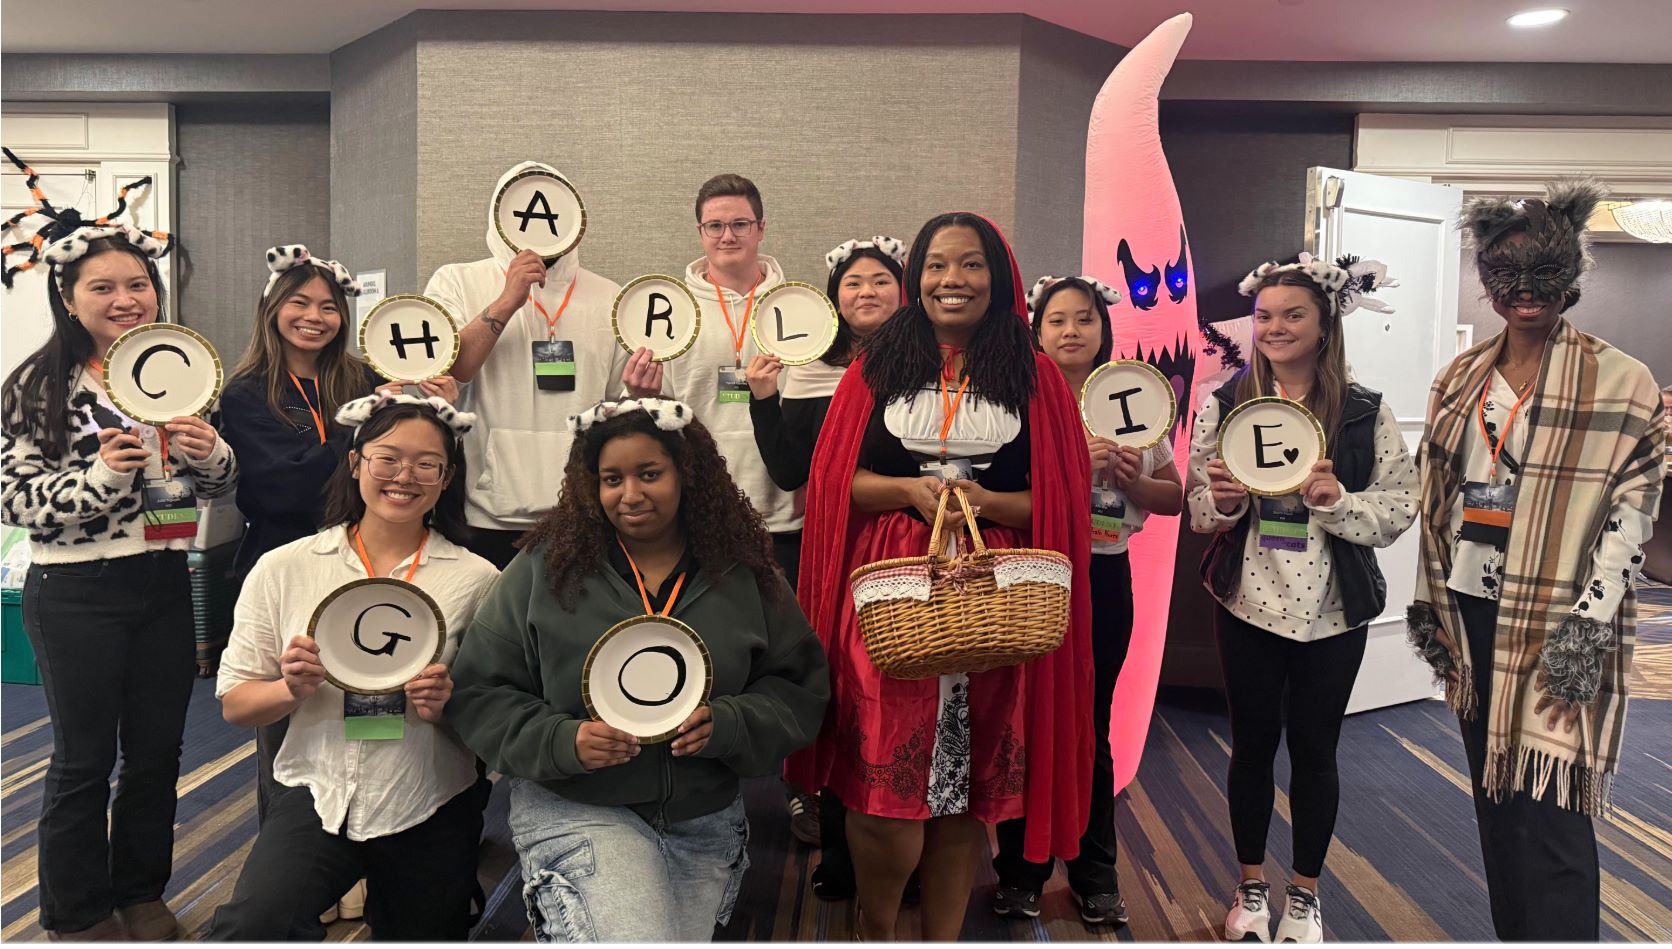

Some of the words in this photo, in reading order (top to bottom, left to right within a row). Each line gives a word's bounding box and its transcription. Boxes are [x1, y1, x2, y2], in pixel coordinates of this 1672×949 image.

[513, 191, 558, 237] A
[645, 293, 674, 339] R
[773, 306, 808, 342] L
[389, 320, 440, 360] H
[131, 343, 191, 399] C
[1109, 387, 1149, 436] I
[1252, 424, 1286, 468] E
[352, 602, 412, 657] G
[617, 645, 687, 707] O
